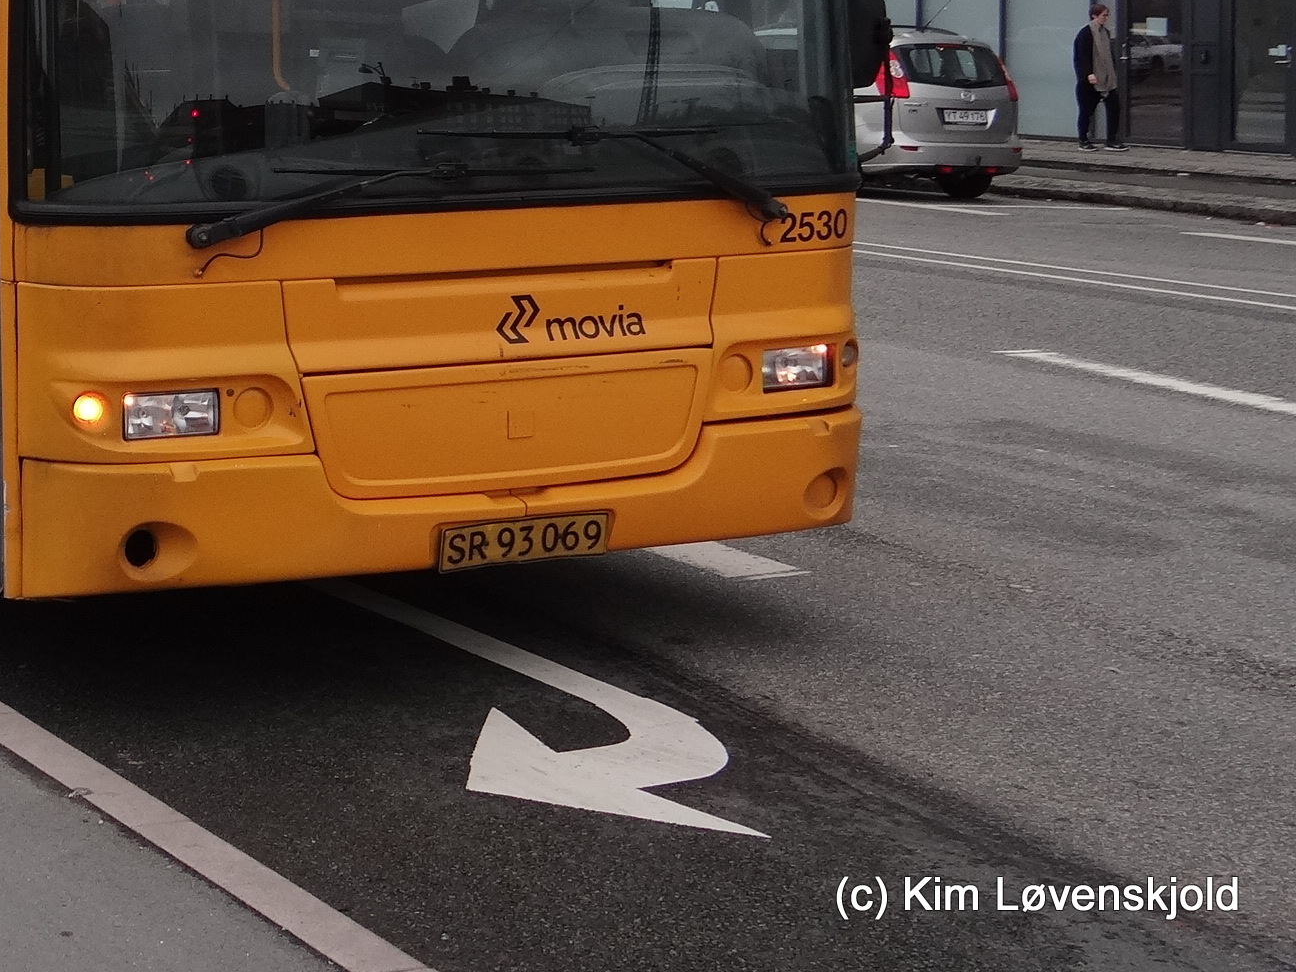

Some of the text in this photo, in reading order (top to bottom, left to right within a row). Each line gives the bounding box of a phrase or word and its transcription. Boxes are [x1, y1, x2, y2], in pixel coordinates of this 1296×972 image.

[779, 208, 848, 244] 2530
[544, 304, 647, 343] movia
[447, 519, 603, 566] SR 93 069
